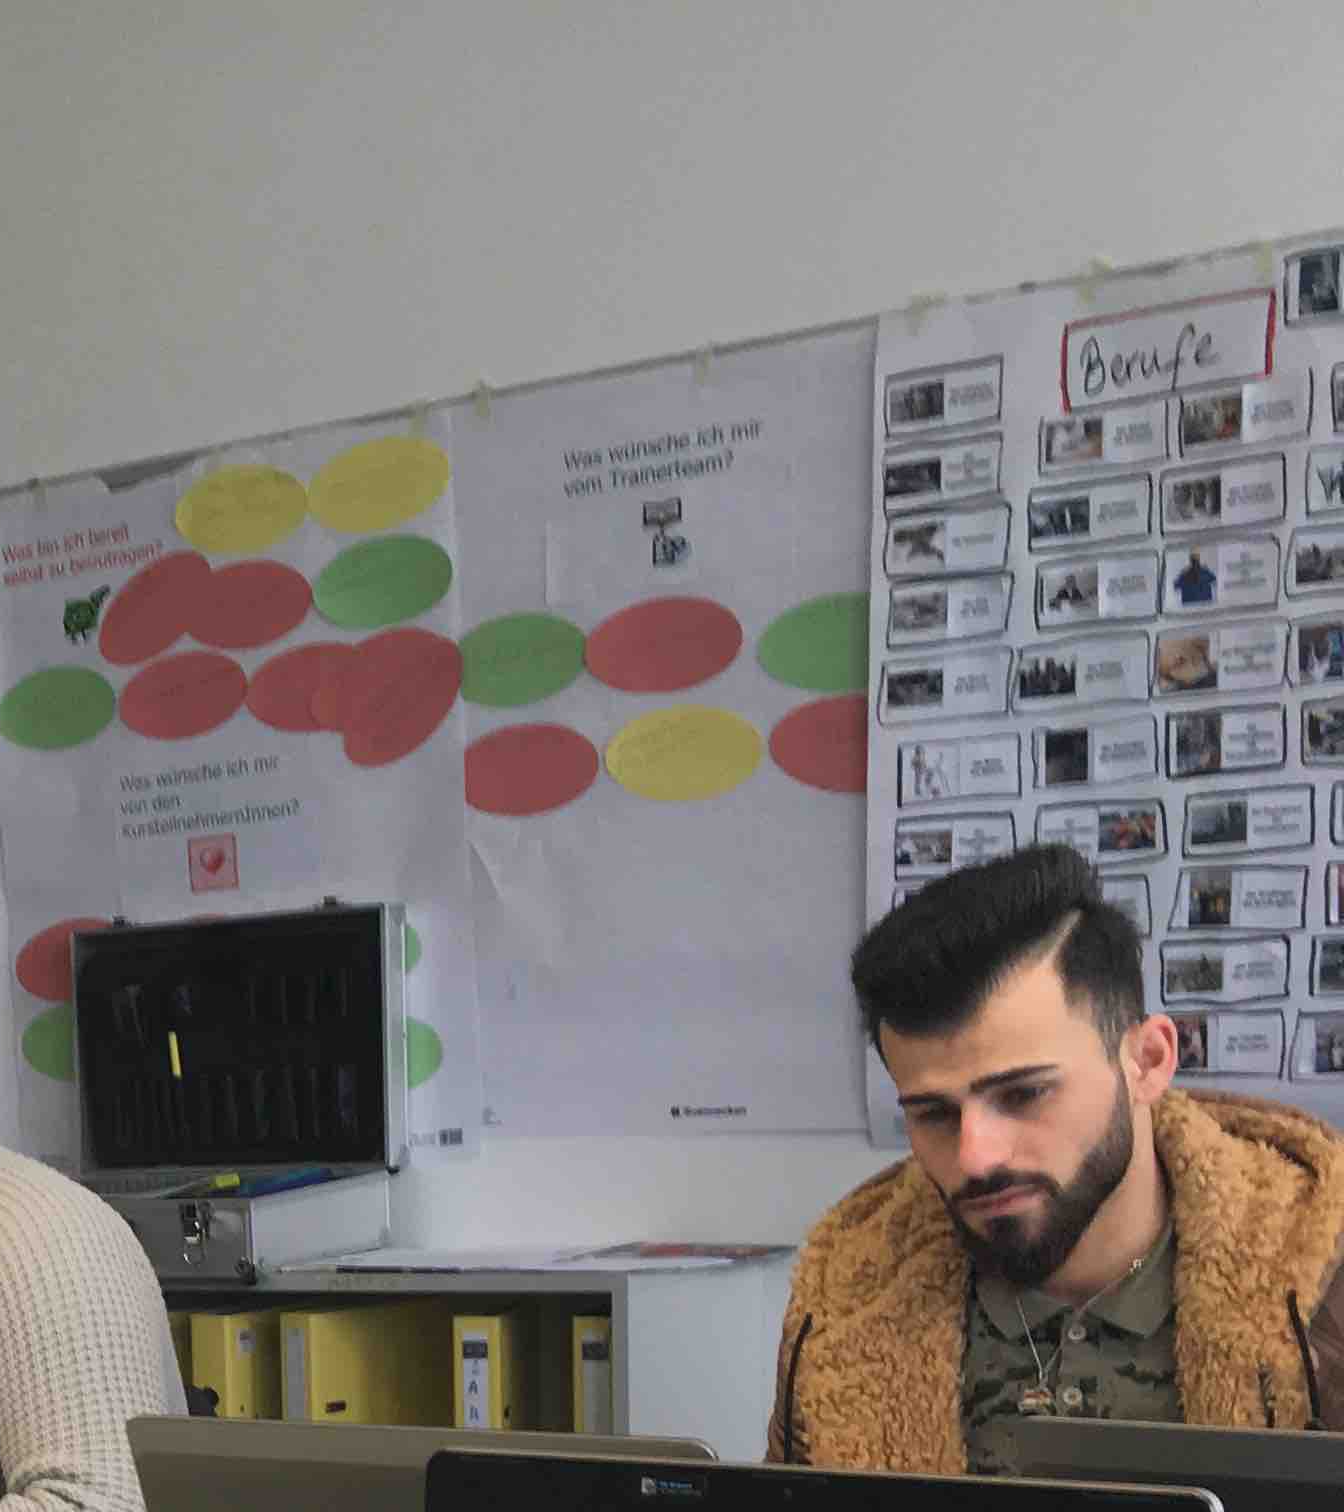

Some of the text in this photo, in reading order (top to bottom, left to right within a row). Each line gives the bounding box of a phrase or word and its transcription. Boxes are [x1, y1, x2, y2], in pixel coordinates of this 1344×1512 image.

[1079, 321, 1220, 396] Berufe
[563, 447, 603, 473] Was
[696, 424, 724, 448] ich
[729, 417, 765, 443] mir
[562, 449, 737, 498] vom Trainerteam?
[1, 541, 34, 564] Was
[37, 536, 60, 558] bin
[63, 530, 86, 555] ich
[119, 773, 151, 793] Was
[225, 756, 250, 779] ich
